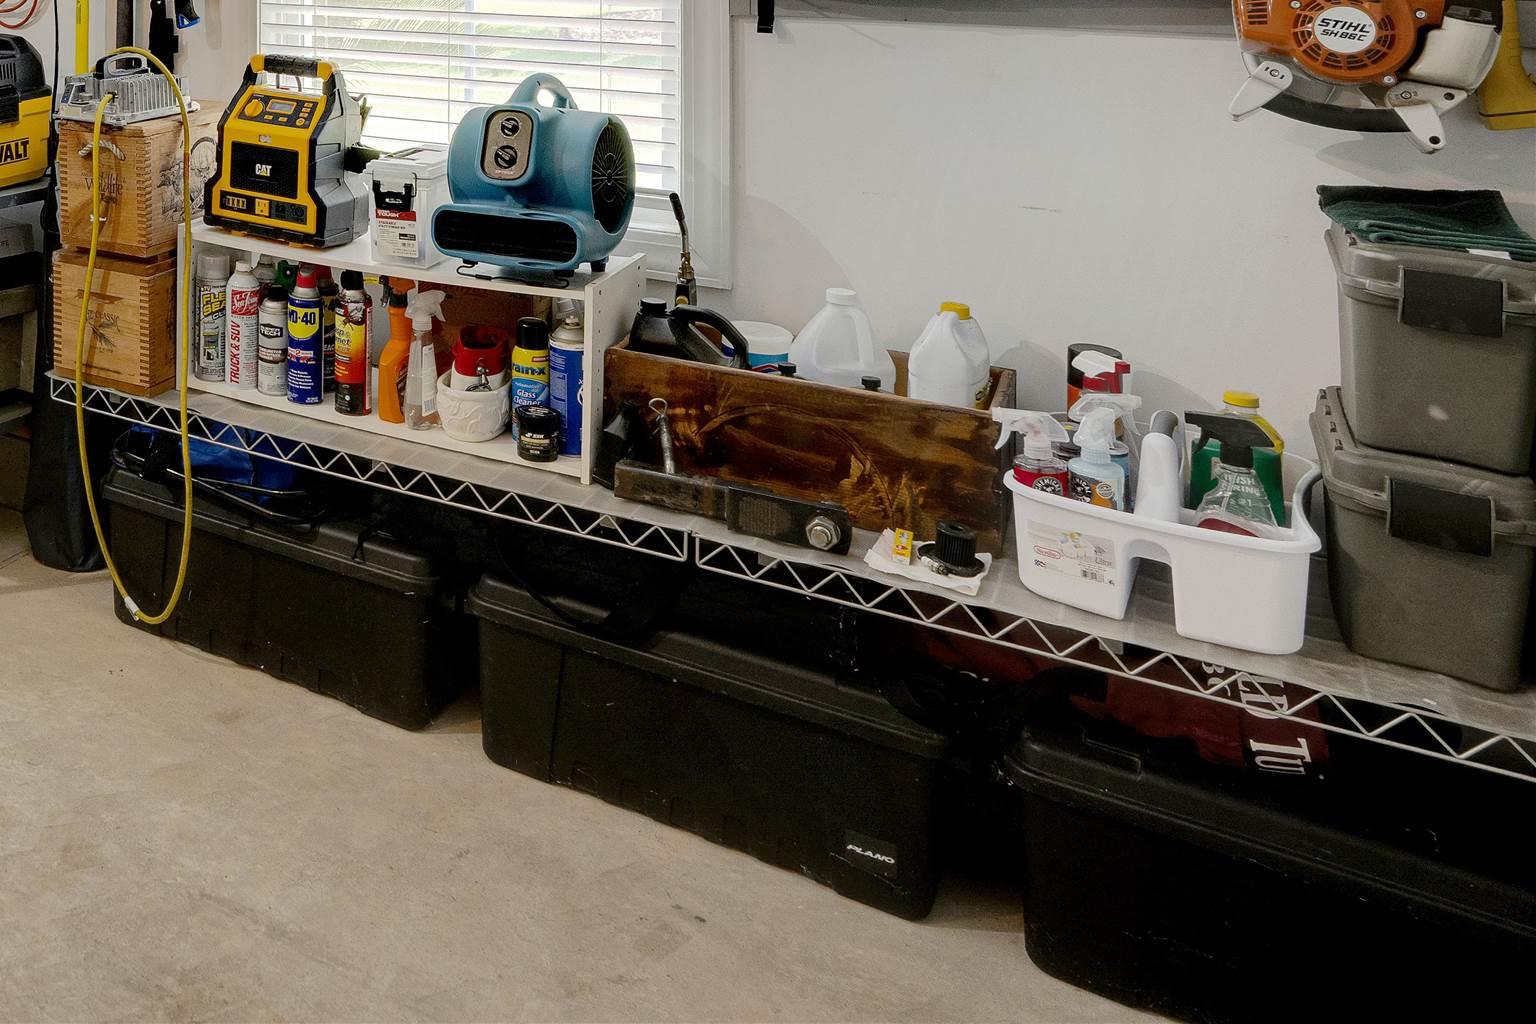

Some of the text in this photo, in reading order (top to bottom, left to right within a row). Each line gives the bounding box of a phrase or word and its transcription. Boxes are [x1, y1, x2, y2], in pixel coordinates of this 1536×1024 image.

[1317, 17, 1371, 34] STIHL
[255, 163, 273, 177] CAT
[202, 292, 226, 305] FLE
[203, 299, 226, 316] SEA
[230, 320, 241, 343] SUV
[229, 353, 241, 385] TRUCK
[513, 395, 542, 406] Cleaner
[516, 388, 537, 399] Glass
[845, 843, 896, 865] PLANO
